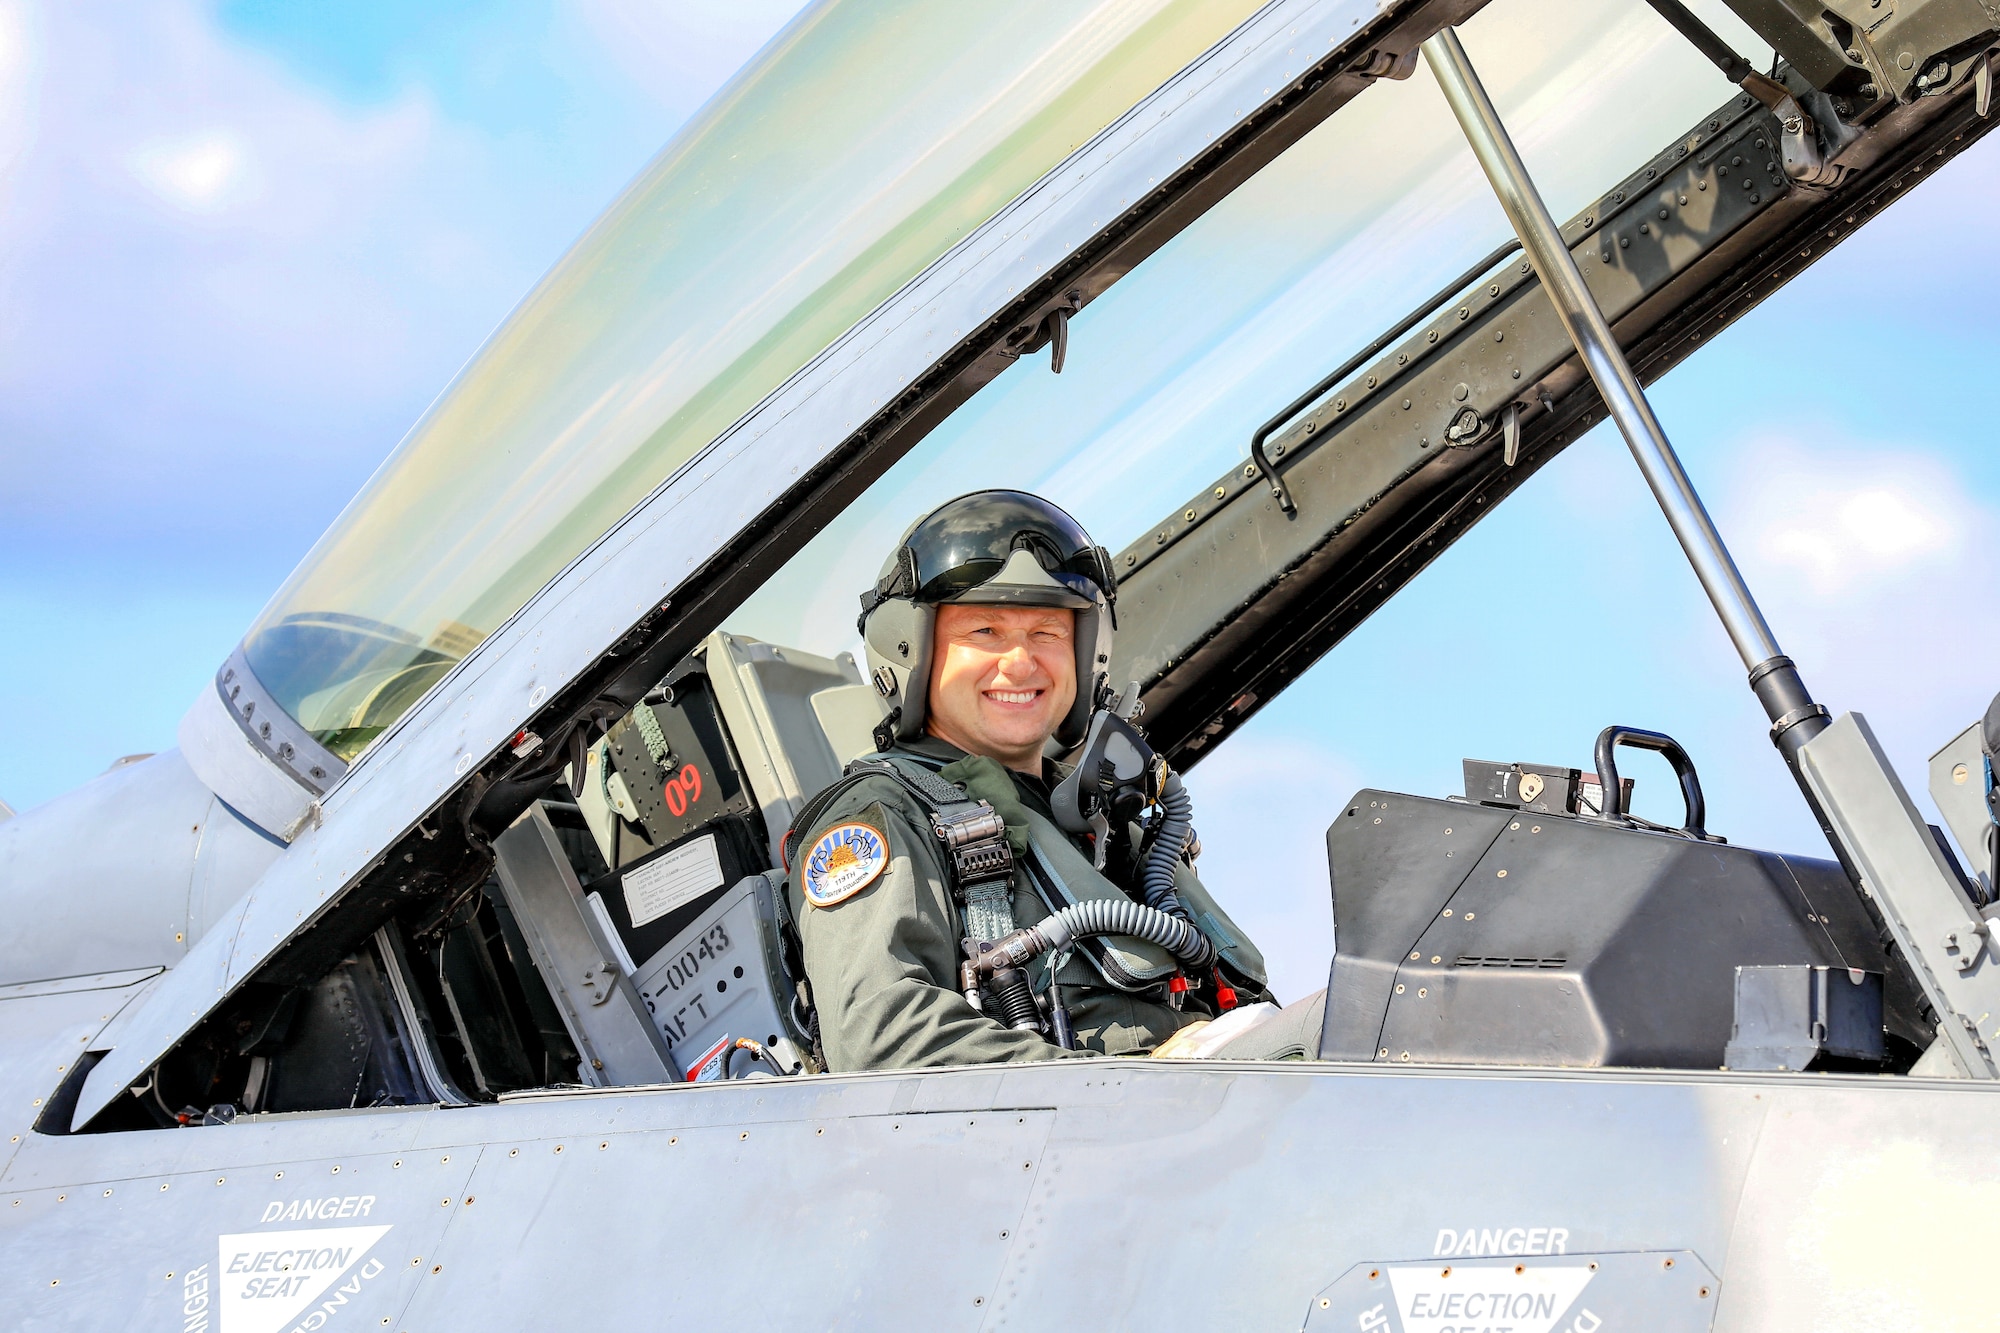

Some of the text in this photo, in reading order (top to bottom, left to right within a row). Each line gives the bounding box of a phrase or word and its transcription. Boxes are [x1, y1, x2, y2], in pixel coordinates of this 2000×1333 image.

[665, 763, 702, 817] 09
[663, 993, 707, 1049] AFT
[260, 1195, 376, 1222] DANGER
[1433, 1228, 1568, 1255] DANGER
[226, 1247, 353, 1274] EJECTION
[241, 1276, 311, 1299] SEAT
[291, 1258, 385, 1333] DANG
[1409, 1293, 1556, 1319] EJECTION
